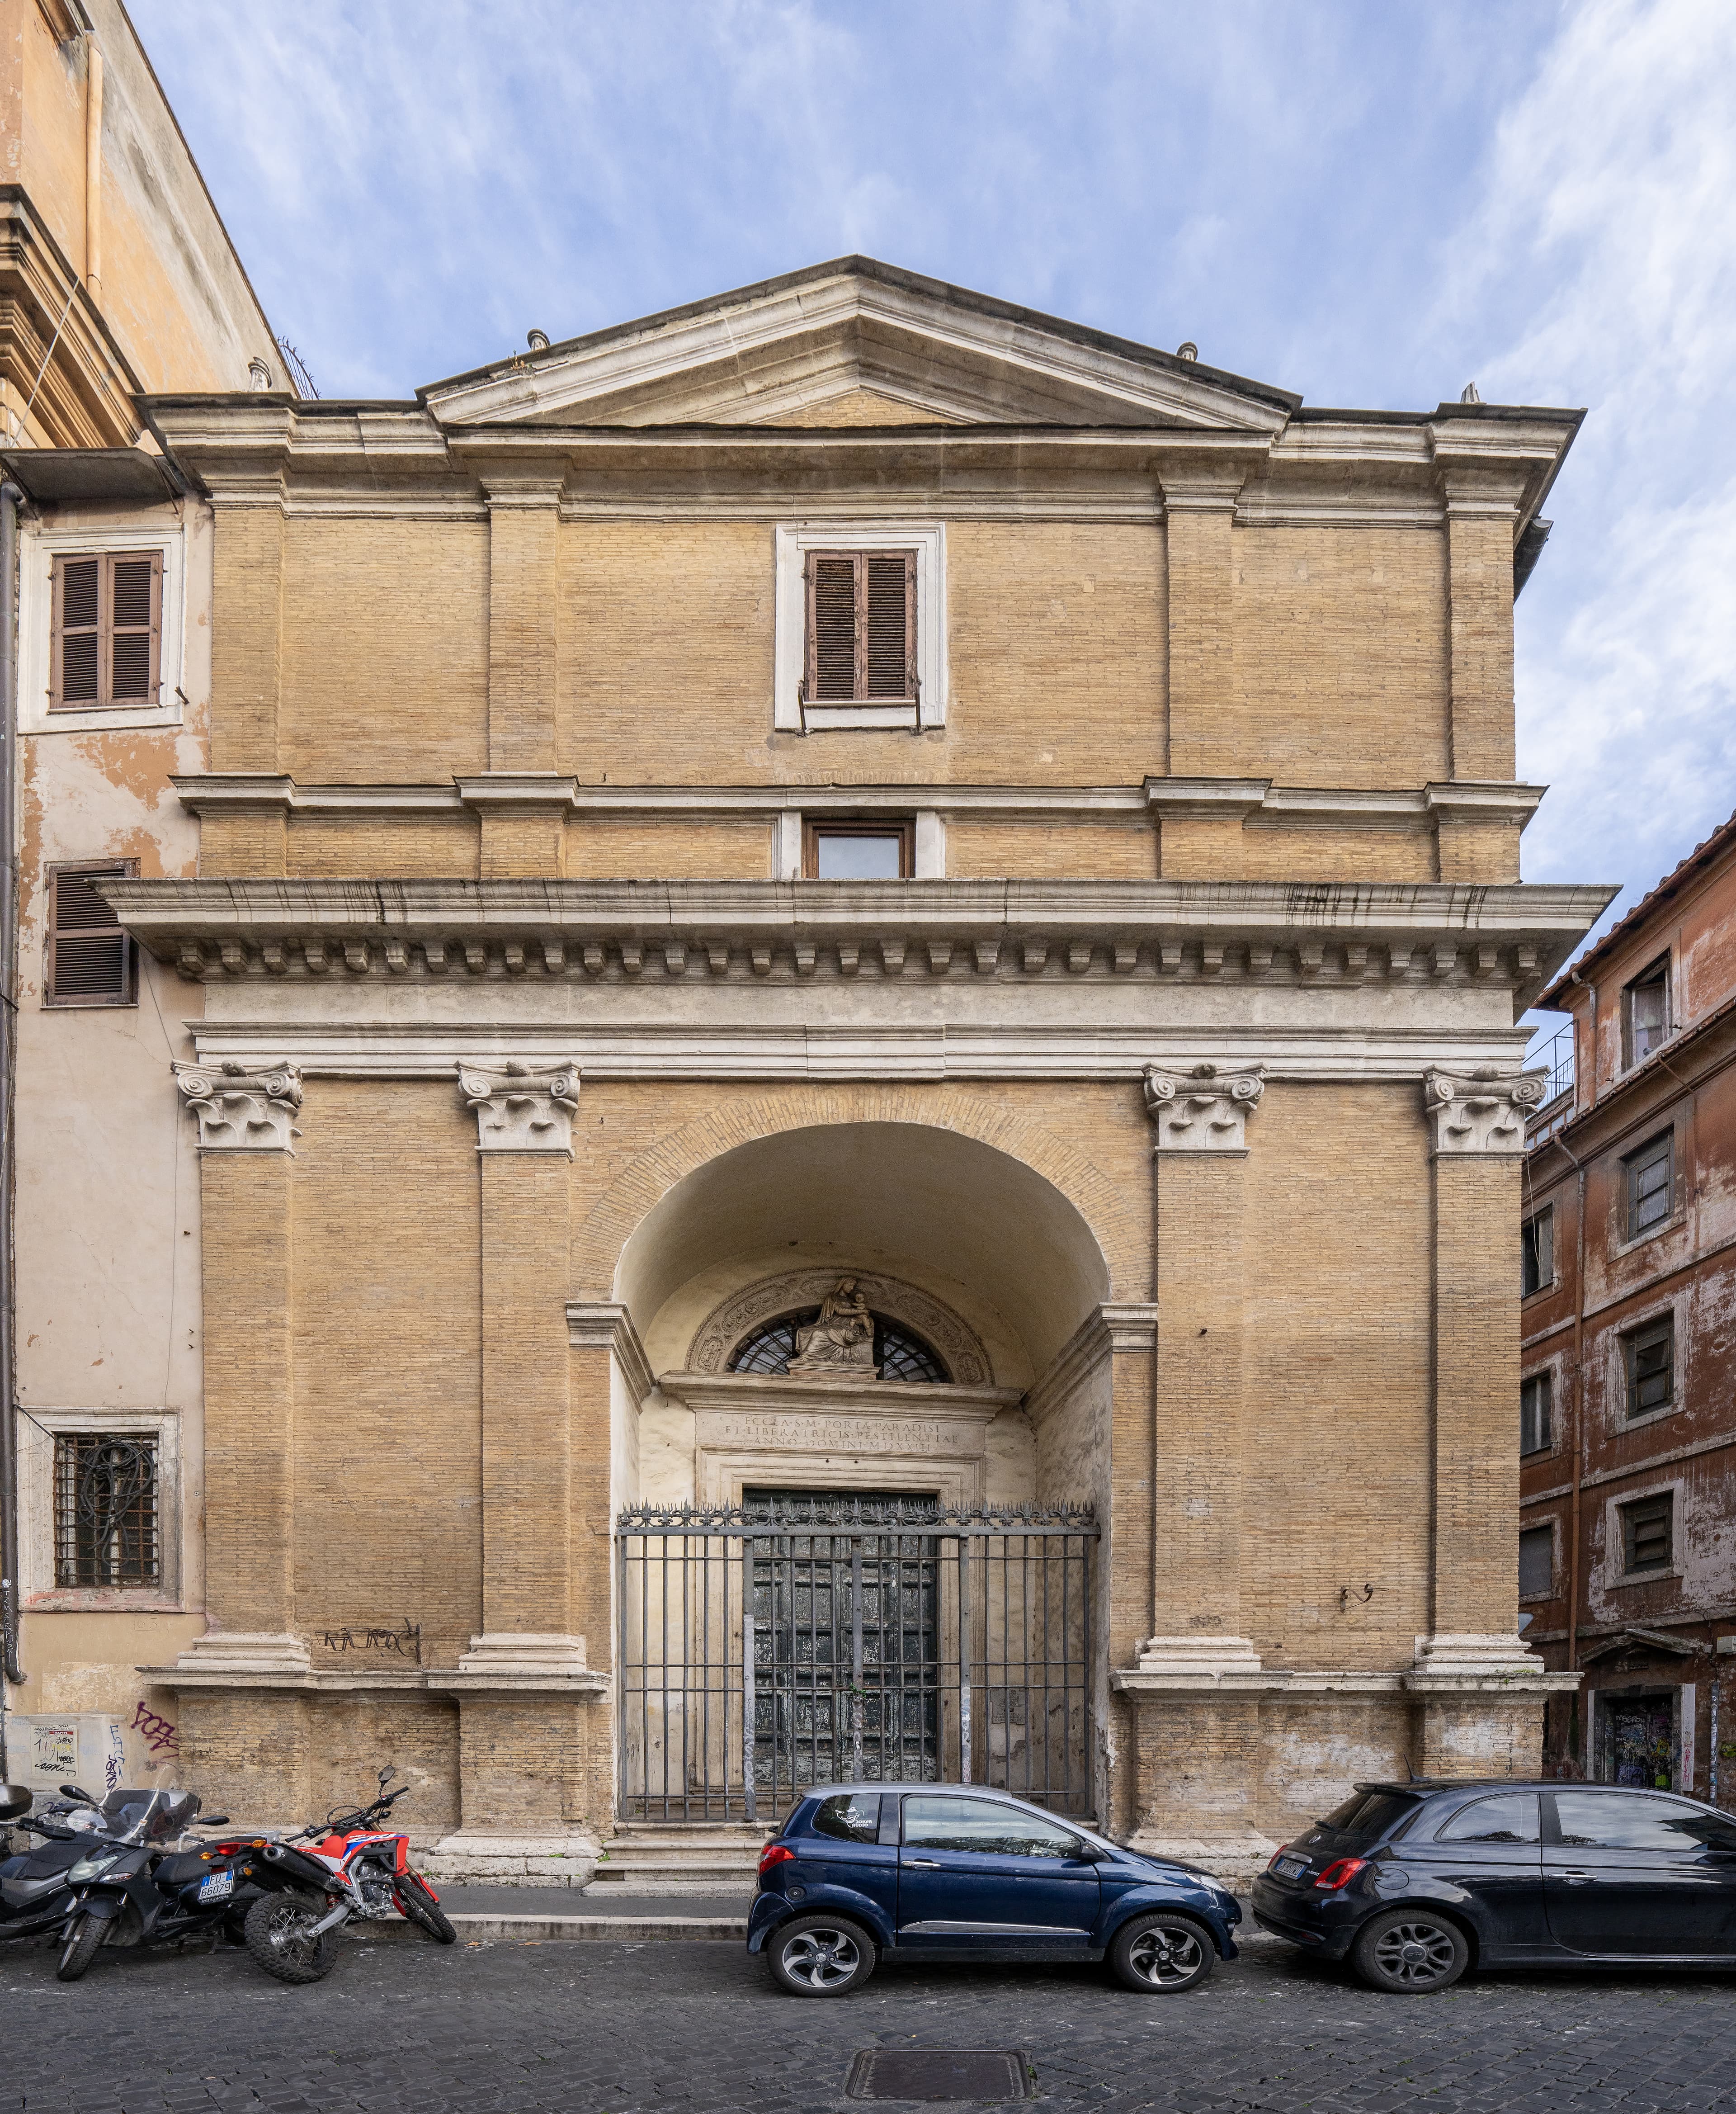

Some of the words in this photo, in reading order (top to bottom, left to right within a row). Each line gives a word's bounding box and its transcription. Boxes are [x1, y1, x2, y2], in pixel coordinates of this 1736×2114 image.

[875, 1422, 939, 1433] PARADISI
[137, 1617, 157, 1629] 63
[210, 1874, 221, 1884] FD
[201, 1882, 231, 1896] 66079
